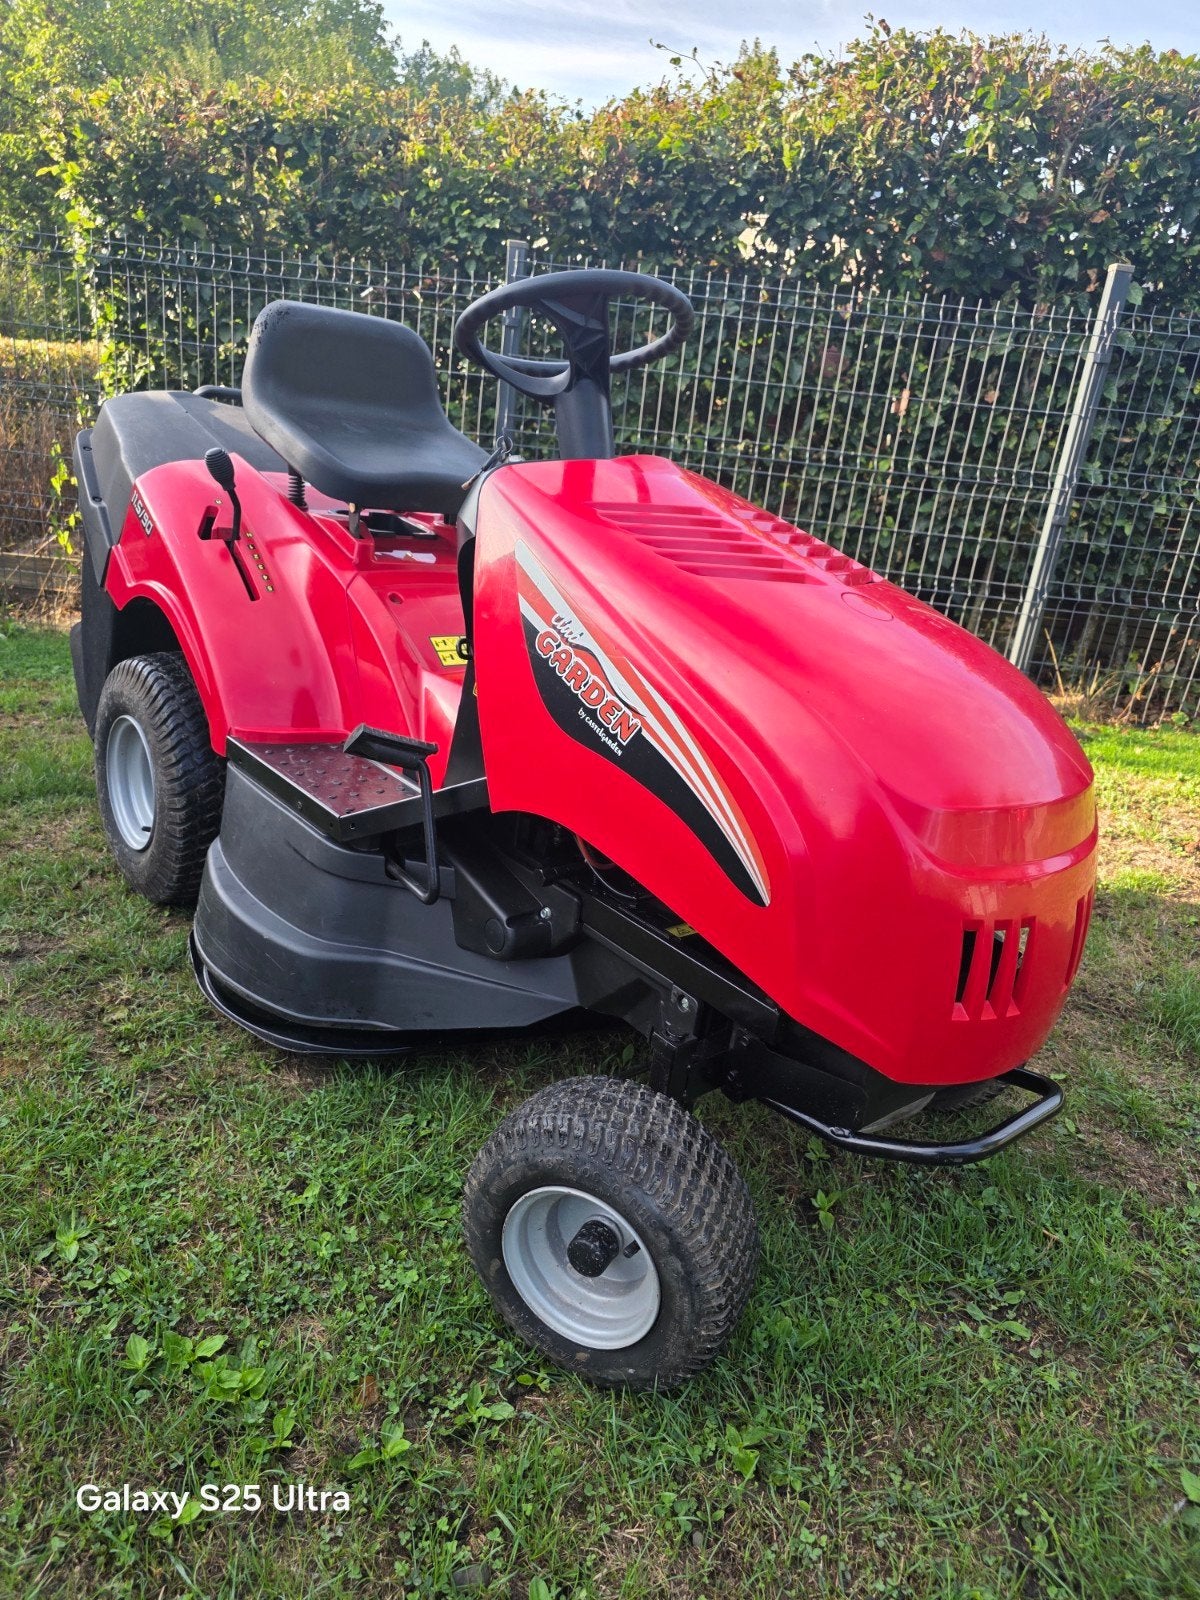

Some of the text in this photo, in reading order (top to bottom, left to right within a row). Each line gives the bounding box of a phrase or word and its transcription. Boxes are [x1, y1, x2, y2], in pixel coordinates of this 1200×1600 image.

[131, 489, 154, 535] 11.5/90
[536, 628, 642, 746] GARDEN
[578, 707, 587, 719] by
